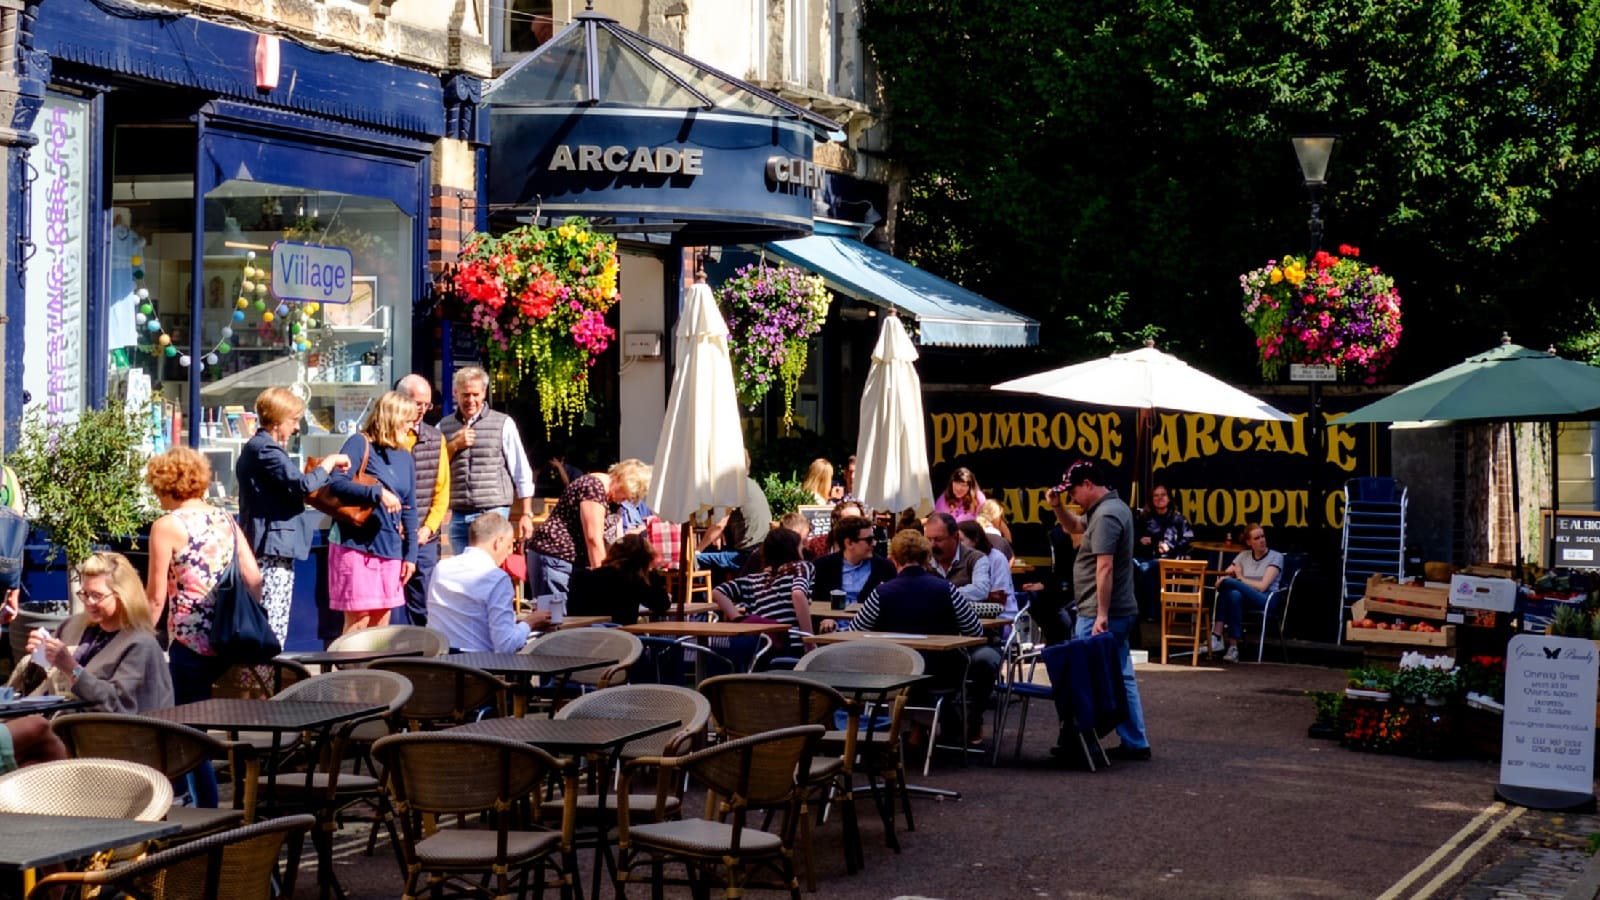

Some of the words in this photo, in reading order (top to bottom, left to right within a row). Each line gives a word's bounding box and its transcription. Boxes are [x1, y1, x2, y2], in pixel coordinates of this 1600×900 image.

[548, 144, 703, 175] ARCADE
[280, 252, 346, 296] Viilage
[930, 411, 1124, 467] PRIMROSE
